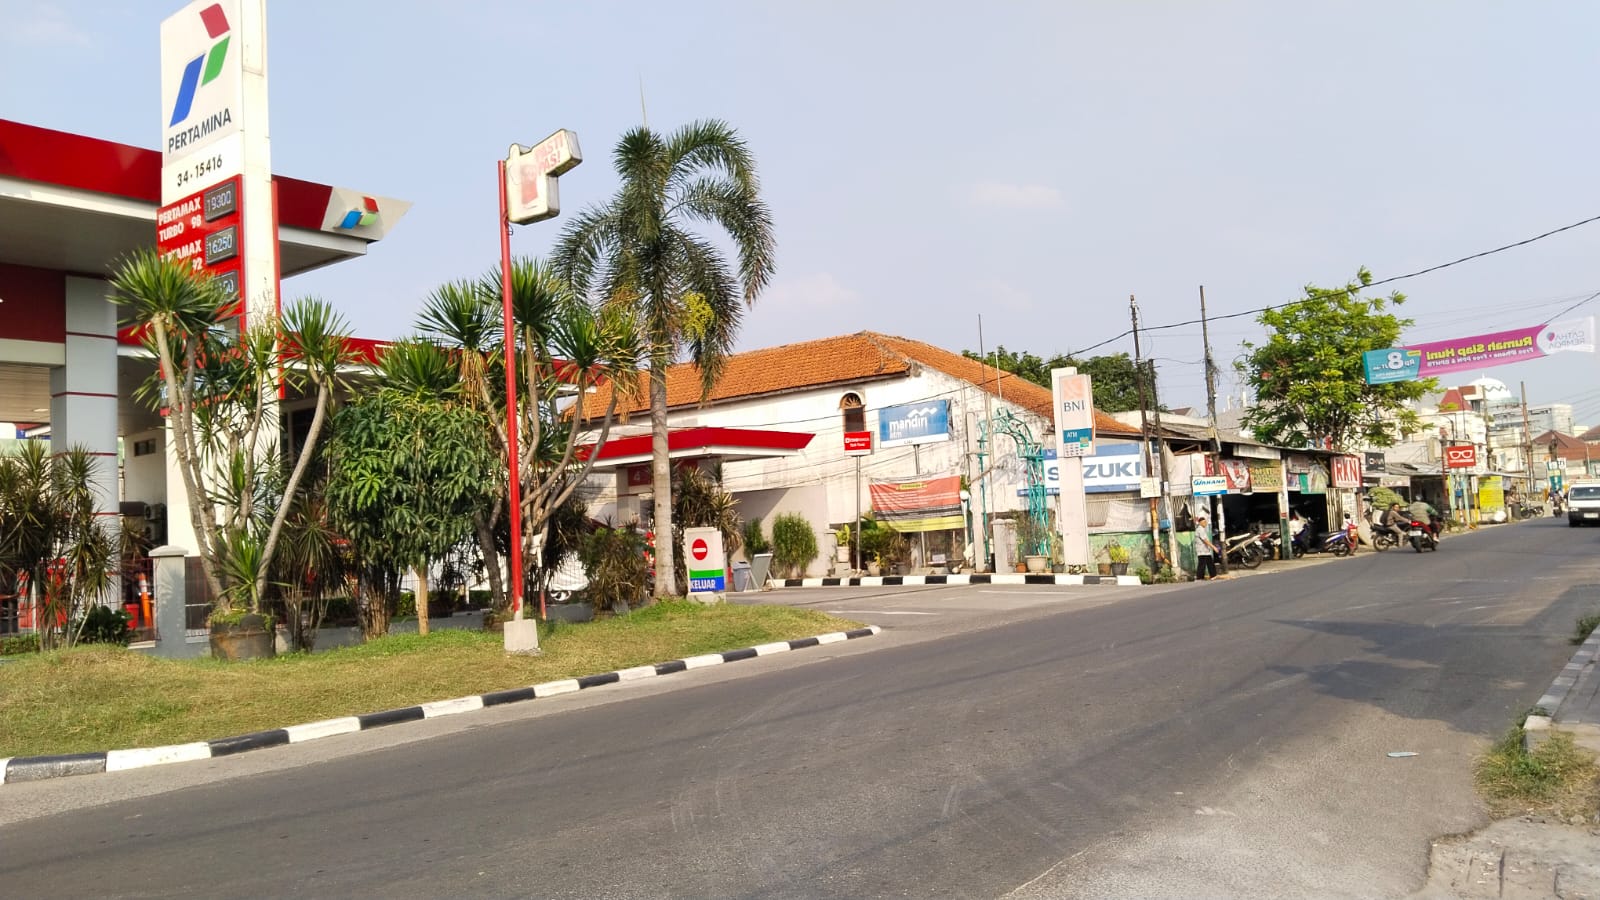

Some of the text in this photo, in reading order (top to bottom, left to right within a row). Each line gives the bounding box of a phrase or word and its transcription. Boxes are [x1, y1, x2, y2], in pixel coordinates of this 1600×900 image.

[168, 107, 231, 153] PERTAMINA
[159, 197, 201, 226] PERTAMAX
[159, 215, 201, 242] TURBO 98
[208, 235, 232, 256] 16250
[1063, 399, 1085, 412] BNI
[888, 415, 928, 435] mandiri
[1047, 461, 1141, 482] SZUKI
[1336, 456, 1359, 481] RKN
[690, 579, 716, 589] KELUAR
